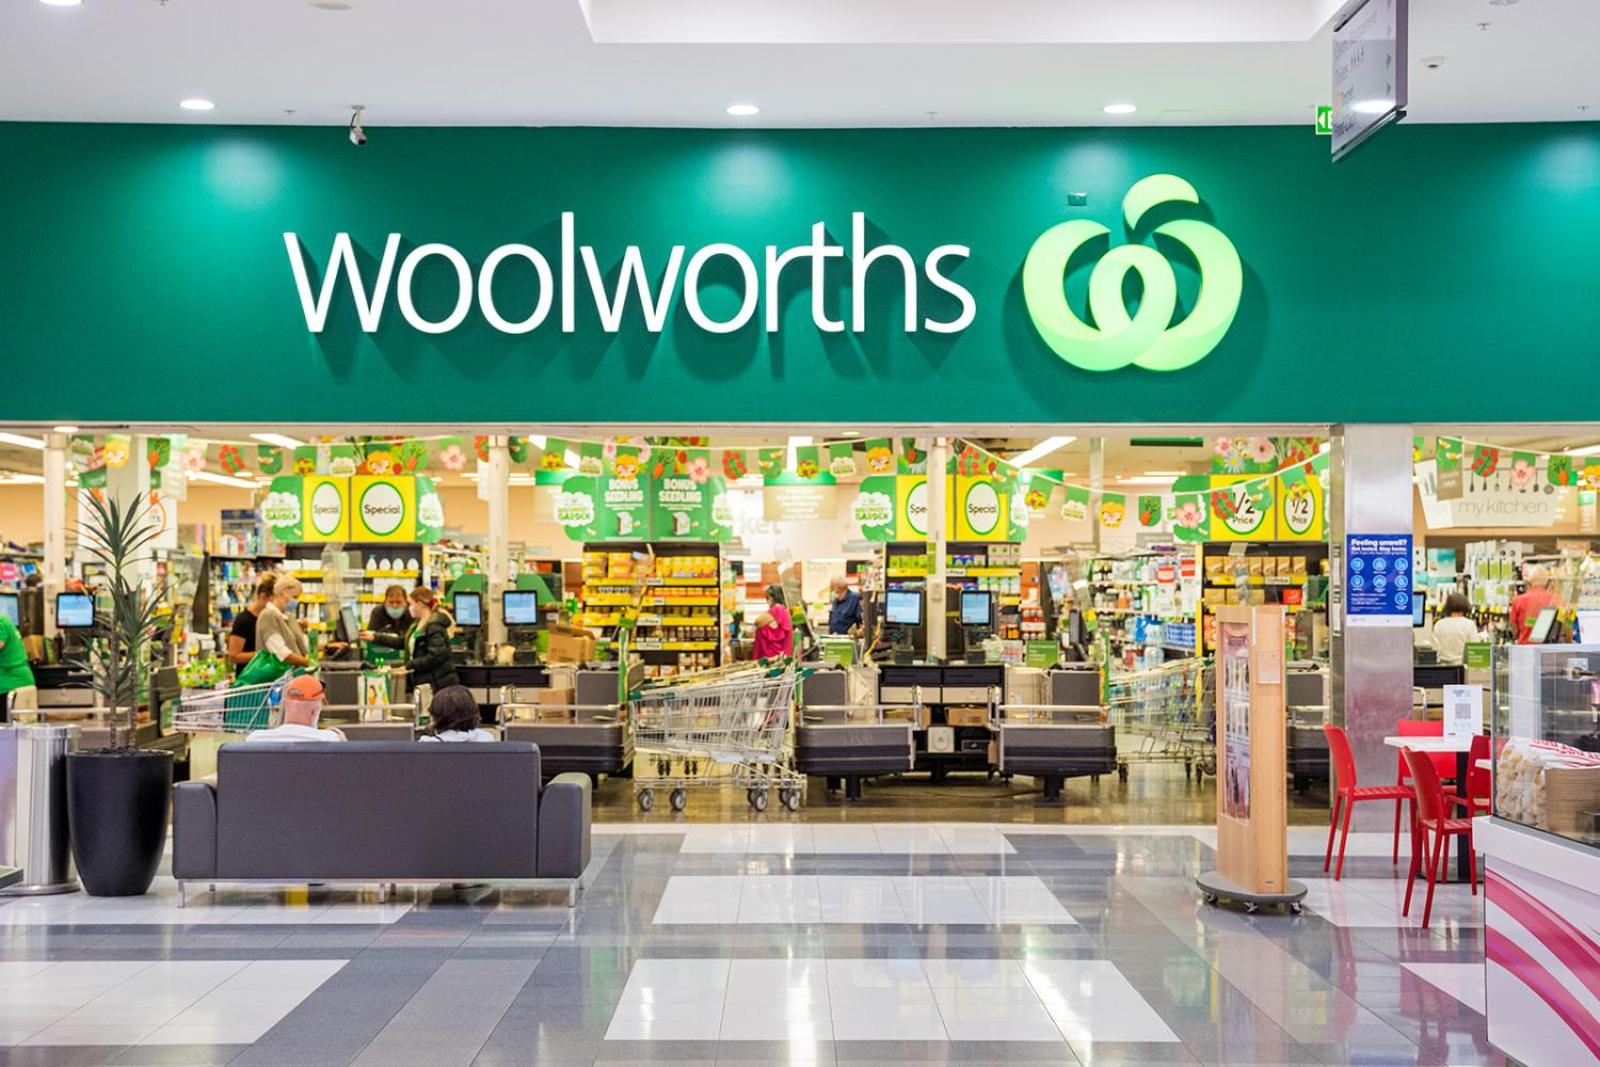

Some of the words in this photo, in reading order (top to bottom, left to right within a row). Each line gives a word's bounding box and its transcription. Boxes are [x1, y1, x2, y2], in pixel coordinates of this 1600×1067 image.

[283, 211, 977, 334] Woolworths
[313, 503, 339, 515] Special
[363, 503, 400, 516] Special
[968, 504, 996, 516] Special
[1458, 501, 1484, 517] my
[1487, 499, 1548, 514] kitchen
[1233, 516, 1254, 525] Price
[1351, 538, 1378, 547] Feeling
[1379, 538, 1408, 546] unwell?
